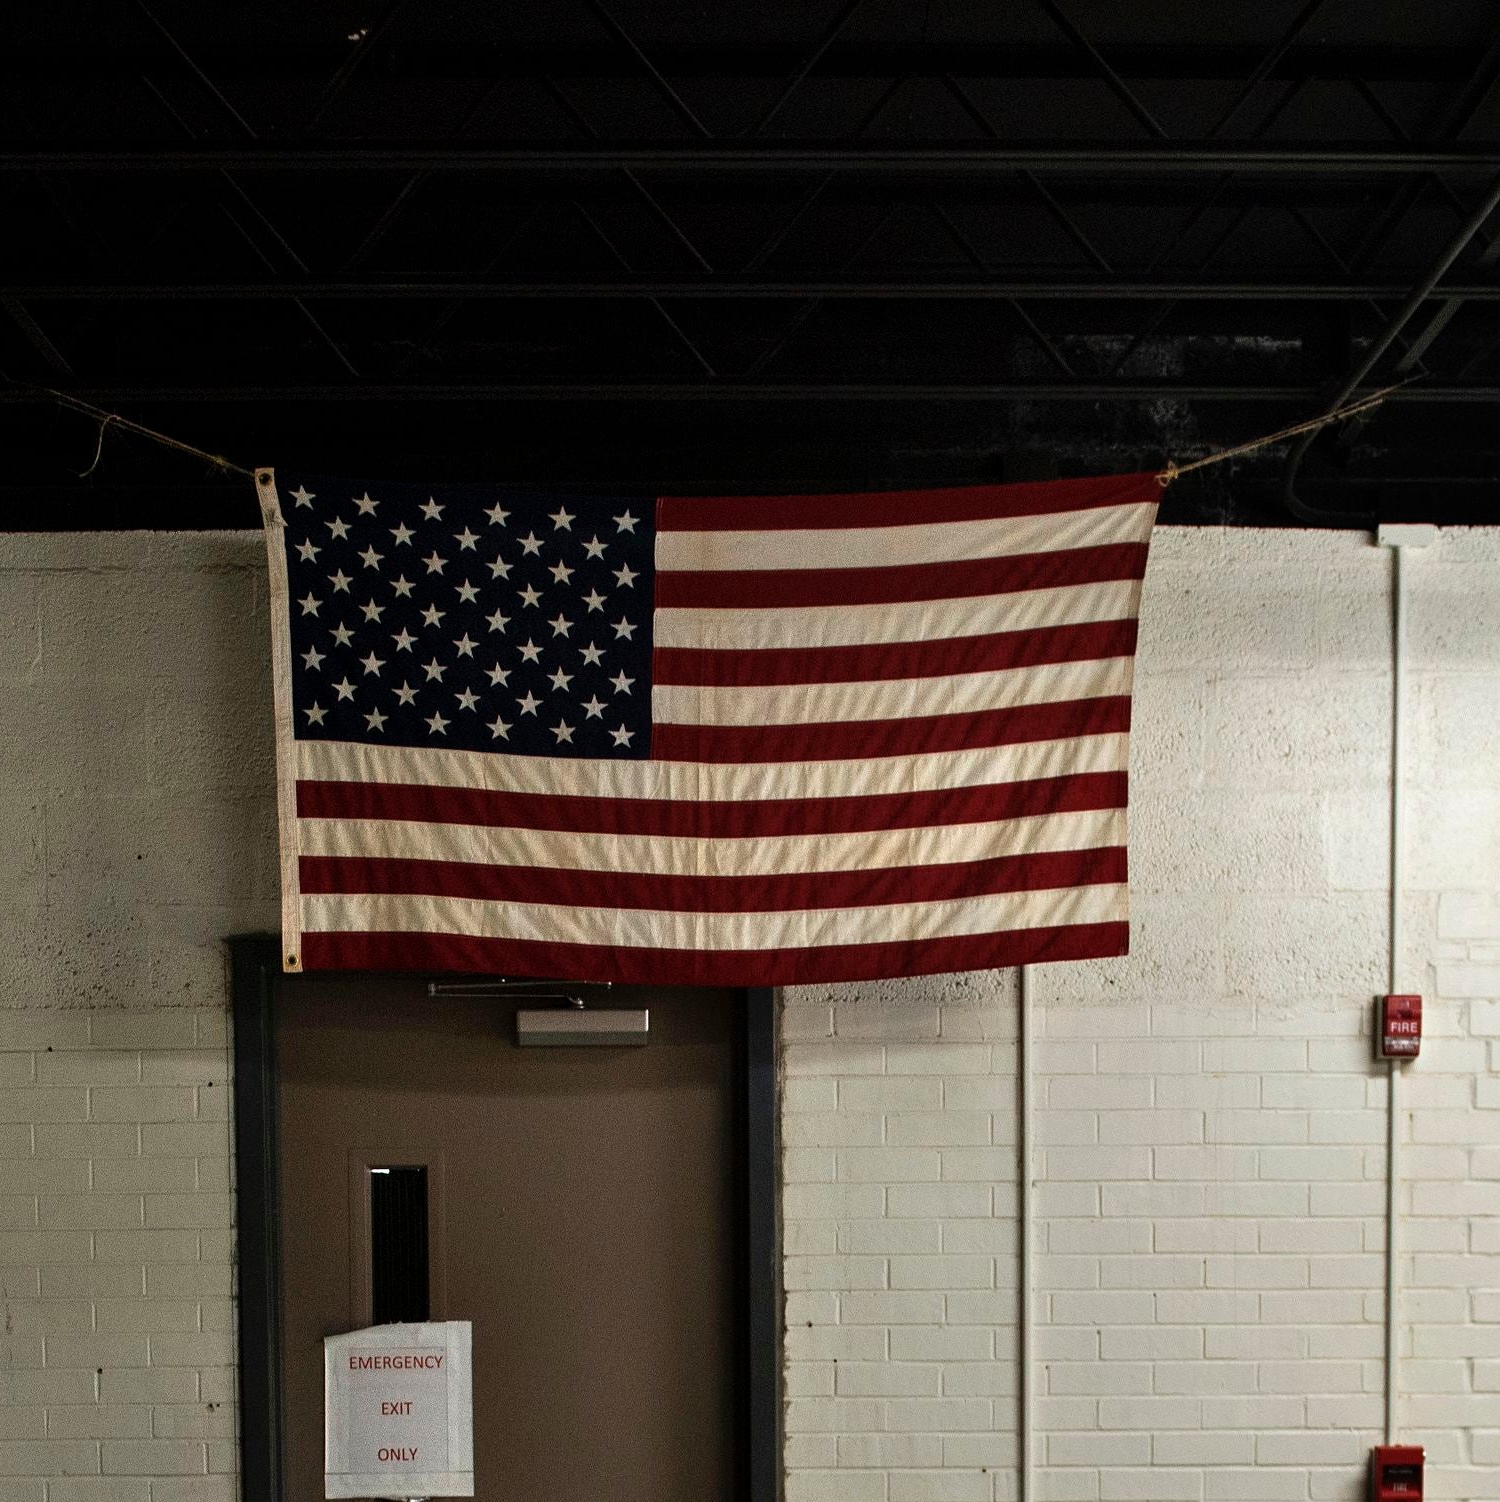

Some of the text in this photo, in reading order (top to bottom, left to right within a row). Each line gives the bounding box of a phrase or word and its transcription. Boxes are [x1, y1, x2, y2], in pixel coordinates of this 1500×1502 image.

[1390, 1021, 1418, 1033] FIRE
[349, 1355, 443, 1370] EMERGENCY
[381, 1401, 413, 1415] EXIT
[377, 1448, 418, 1461] ONLY
